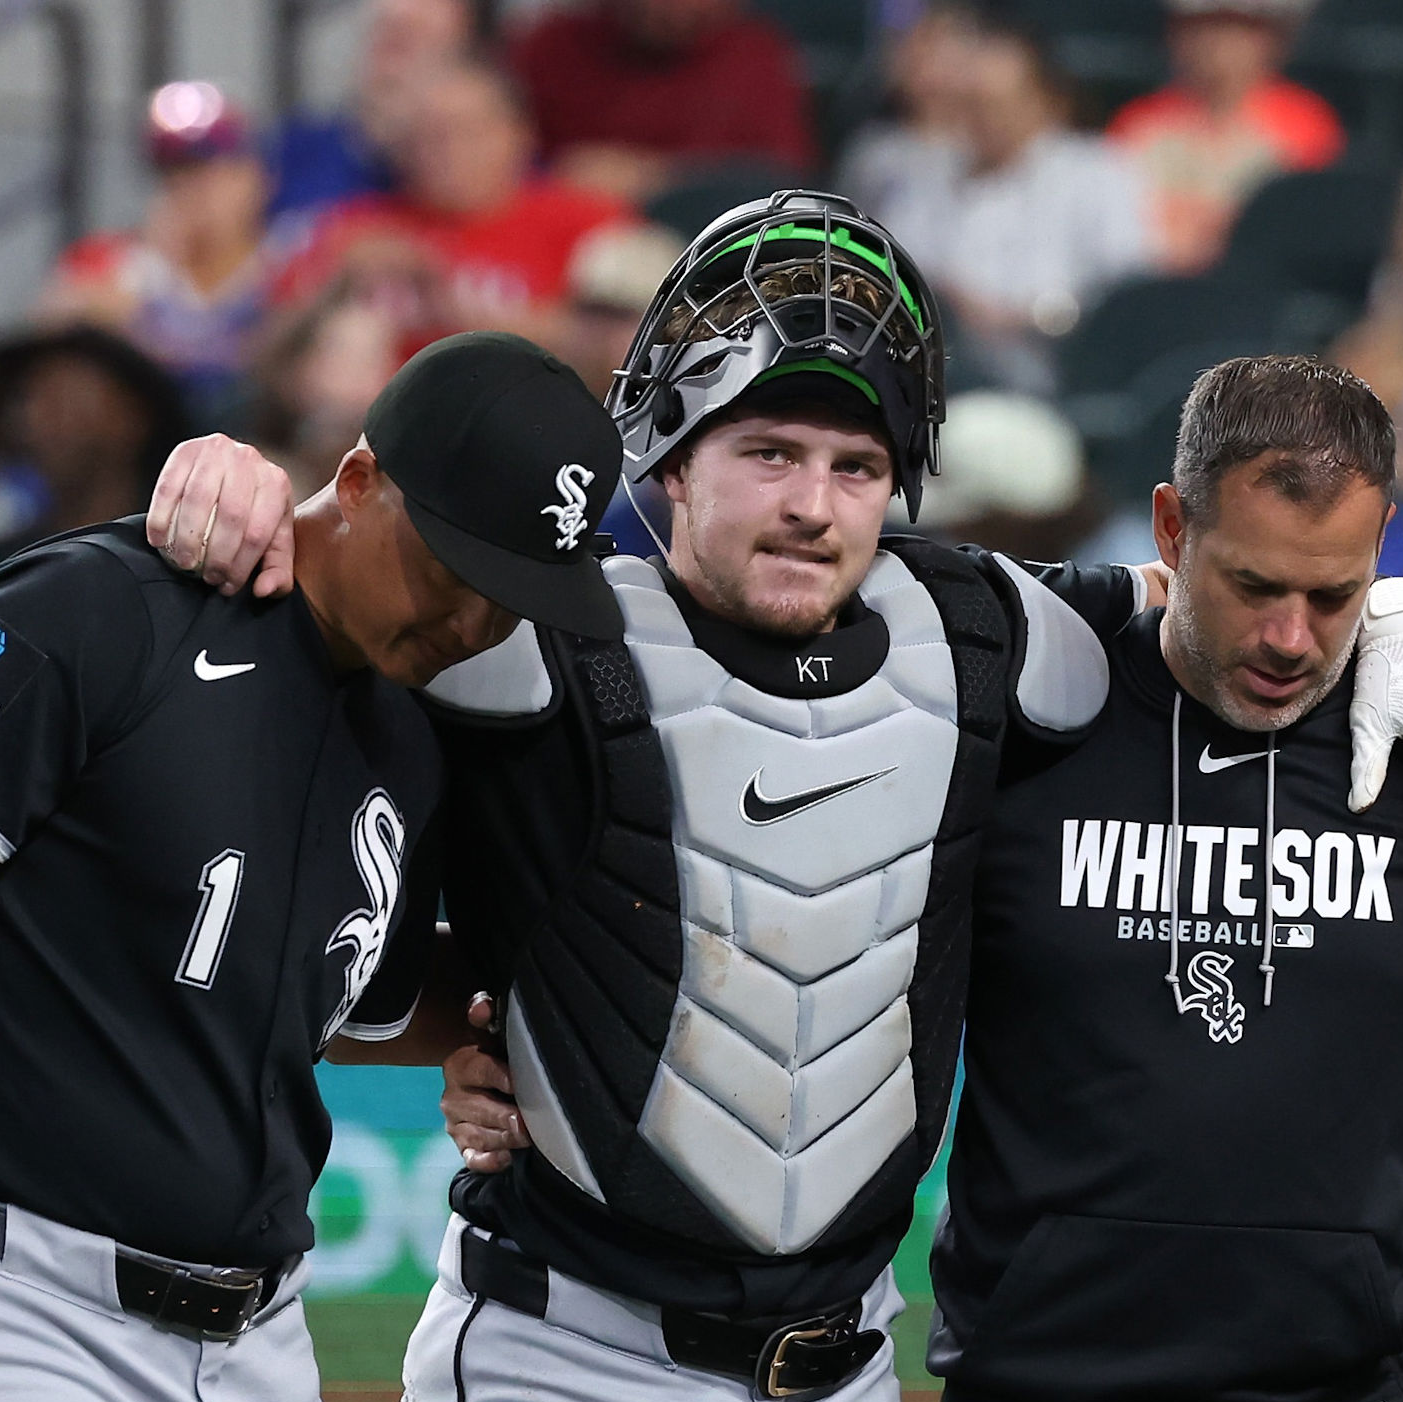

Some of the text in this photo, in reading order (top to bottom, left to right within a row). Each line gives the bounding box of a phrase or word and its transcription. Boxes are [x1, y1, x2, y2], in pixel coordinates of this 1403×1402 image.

[795, 655, 833, 683] KT
[1060, 819, 1396, 922] WHITE SOX
[174, 848, 246, 991] 1
[1117, 916, 1263, 946] BASEBALL
